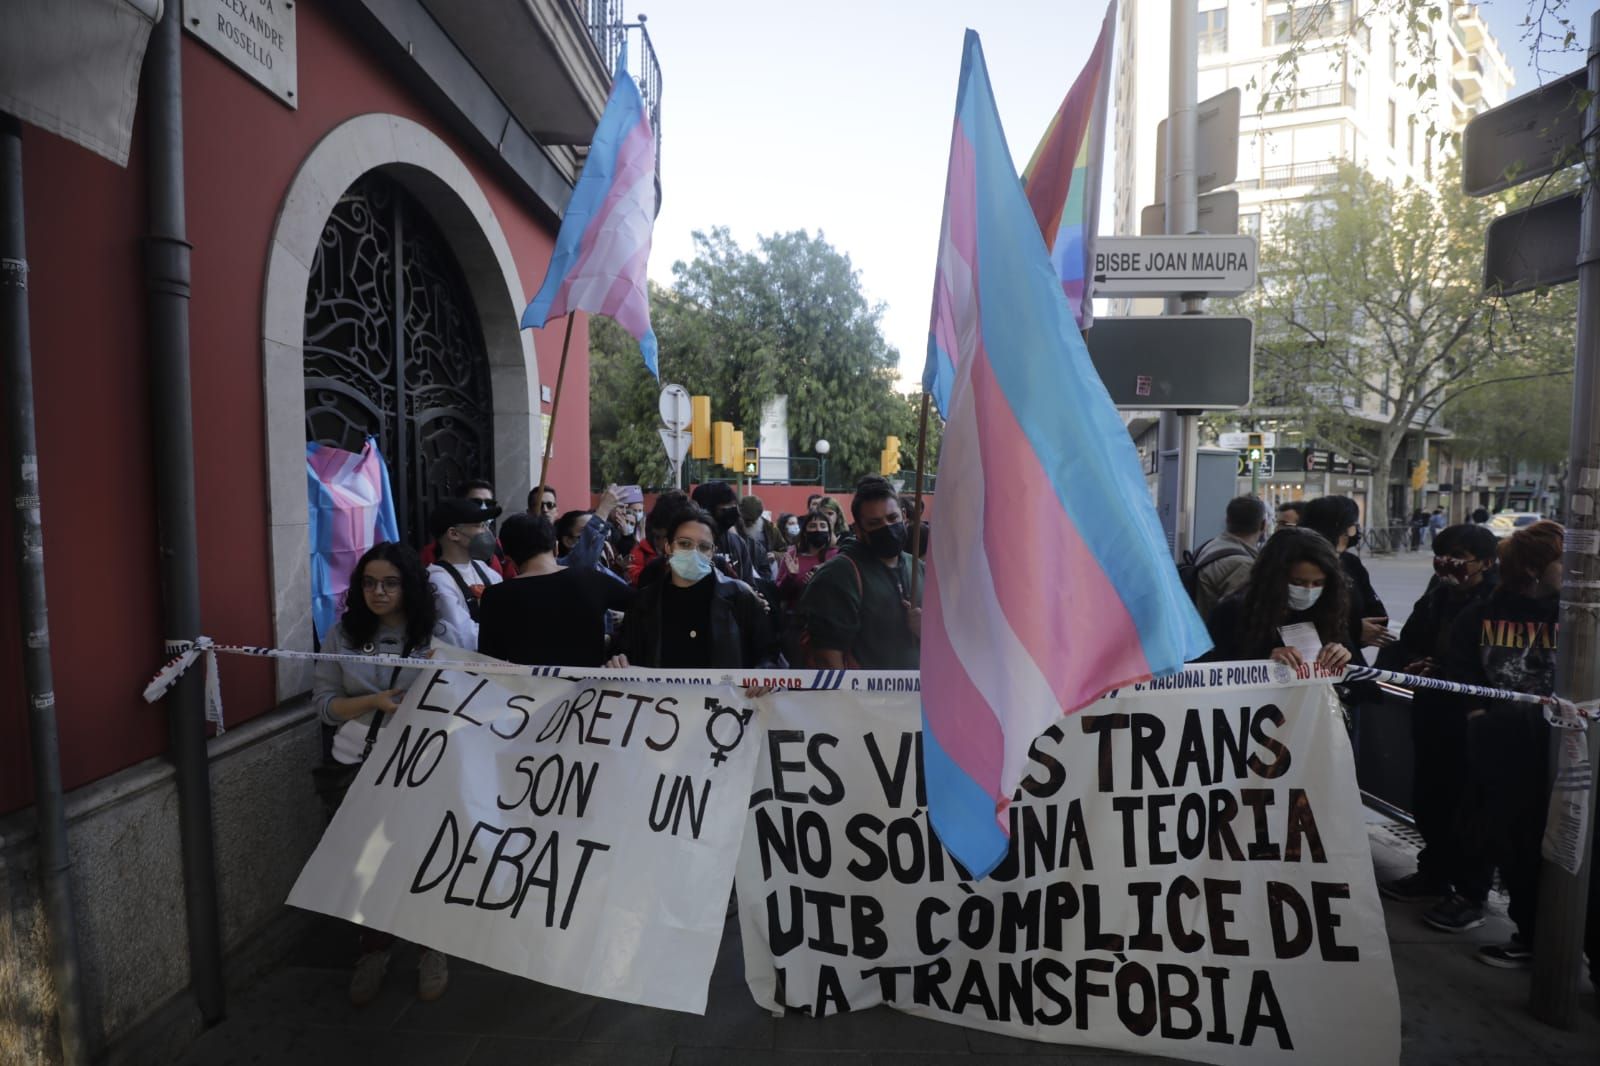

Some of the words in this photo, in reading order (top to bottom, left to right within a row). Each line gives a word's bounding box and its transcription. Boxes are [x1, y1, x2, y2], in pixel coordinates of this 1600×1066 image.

[1095, 252, 1141, 272] BISBE
[1145, 252, 1187, 272] JOAN
[1191, 251, 1248, 272] MAURA
[536, 688, 680, 751] DRETS
[867, 677, 920, 692] NACIONA
[1150, 669, 1206, 690] NACIONAL
[1210, 668, 1223, 687] DE
[1227, 664, 1270, 685] POLICIA
[375, 725, 448, 788] NO
[497, 754, 599, 817] SON
[649, 774, 711, 839] UN
[1081, 704, 1292, 792] TRANS
[410, 810, 610, 930] DEBAT
[755, 806, 832, 881] NO
[1113, 788, 1328, 867] TEORIA
[766, 885, 888, 959] UIB
[916, 875, 1250, 956] CÒMPLICE
[1267, 881, 1360, 962] DE
[860, 953, 1295, 1050] TRANSFÒBIA
